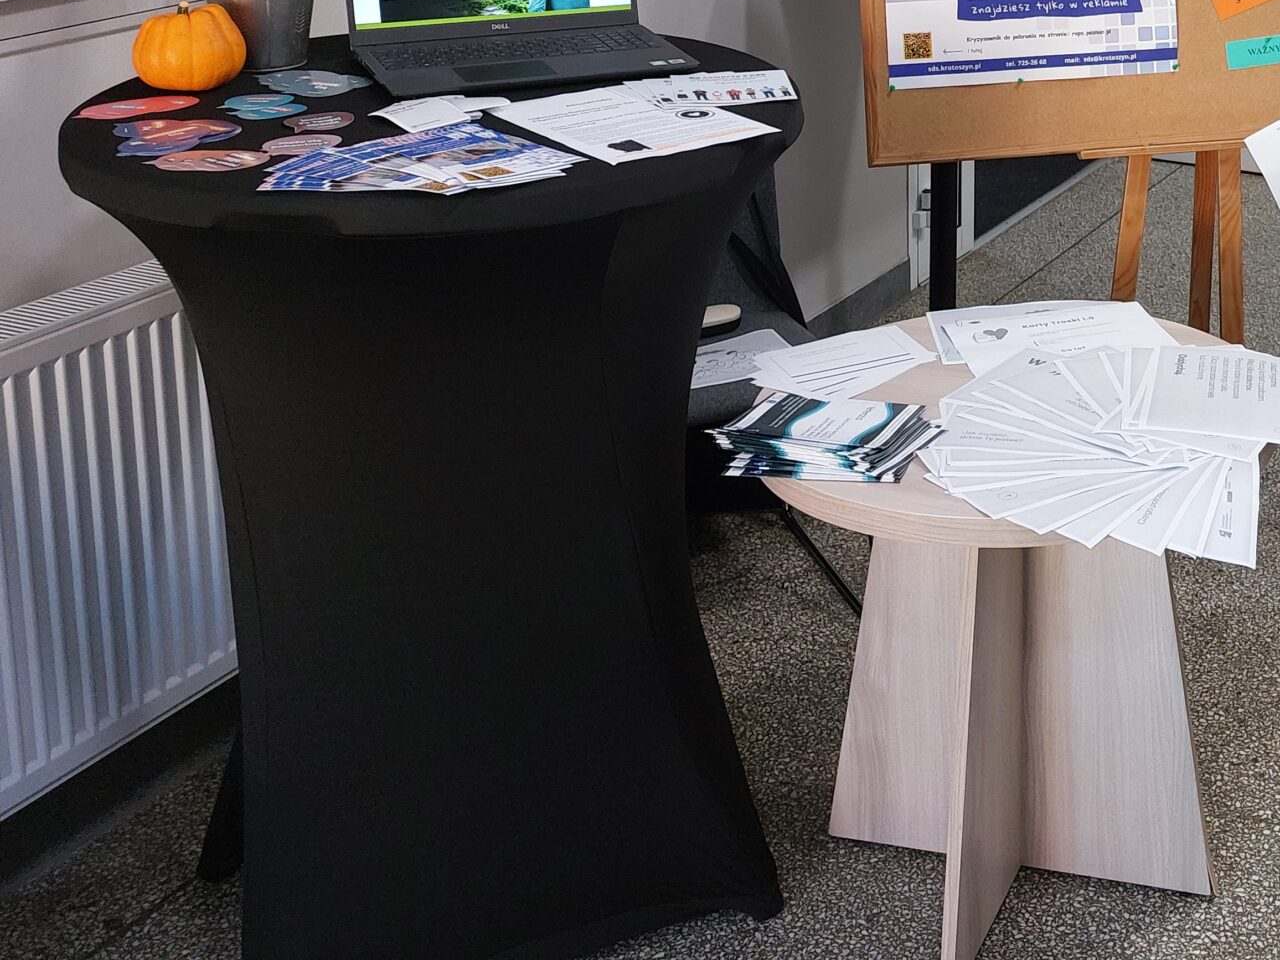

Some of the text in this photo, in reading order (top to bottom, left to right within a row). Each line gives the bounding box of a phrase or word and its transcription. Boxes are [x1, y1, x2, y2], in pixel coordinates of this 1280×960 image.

[971, 2, 1030, 18] znajdziesz
[1036, 1, 1064, 13] tylko
[1069, 1, 1078, 9] w
[927, 62, 981, 72] sds.krotoszyn.pl
[1005, 60, 1016, 68] tel.
[1064, 56, 1081, 64] mail:
[1083, 53, 1137, 63] sds@krotoszyn.pl
